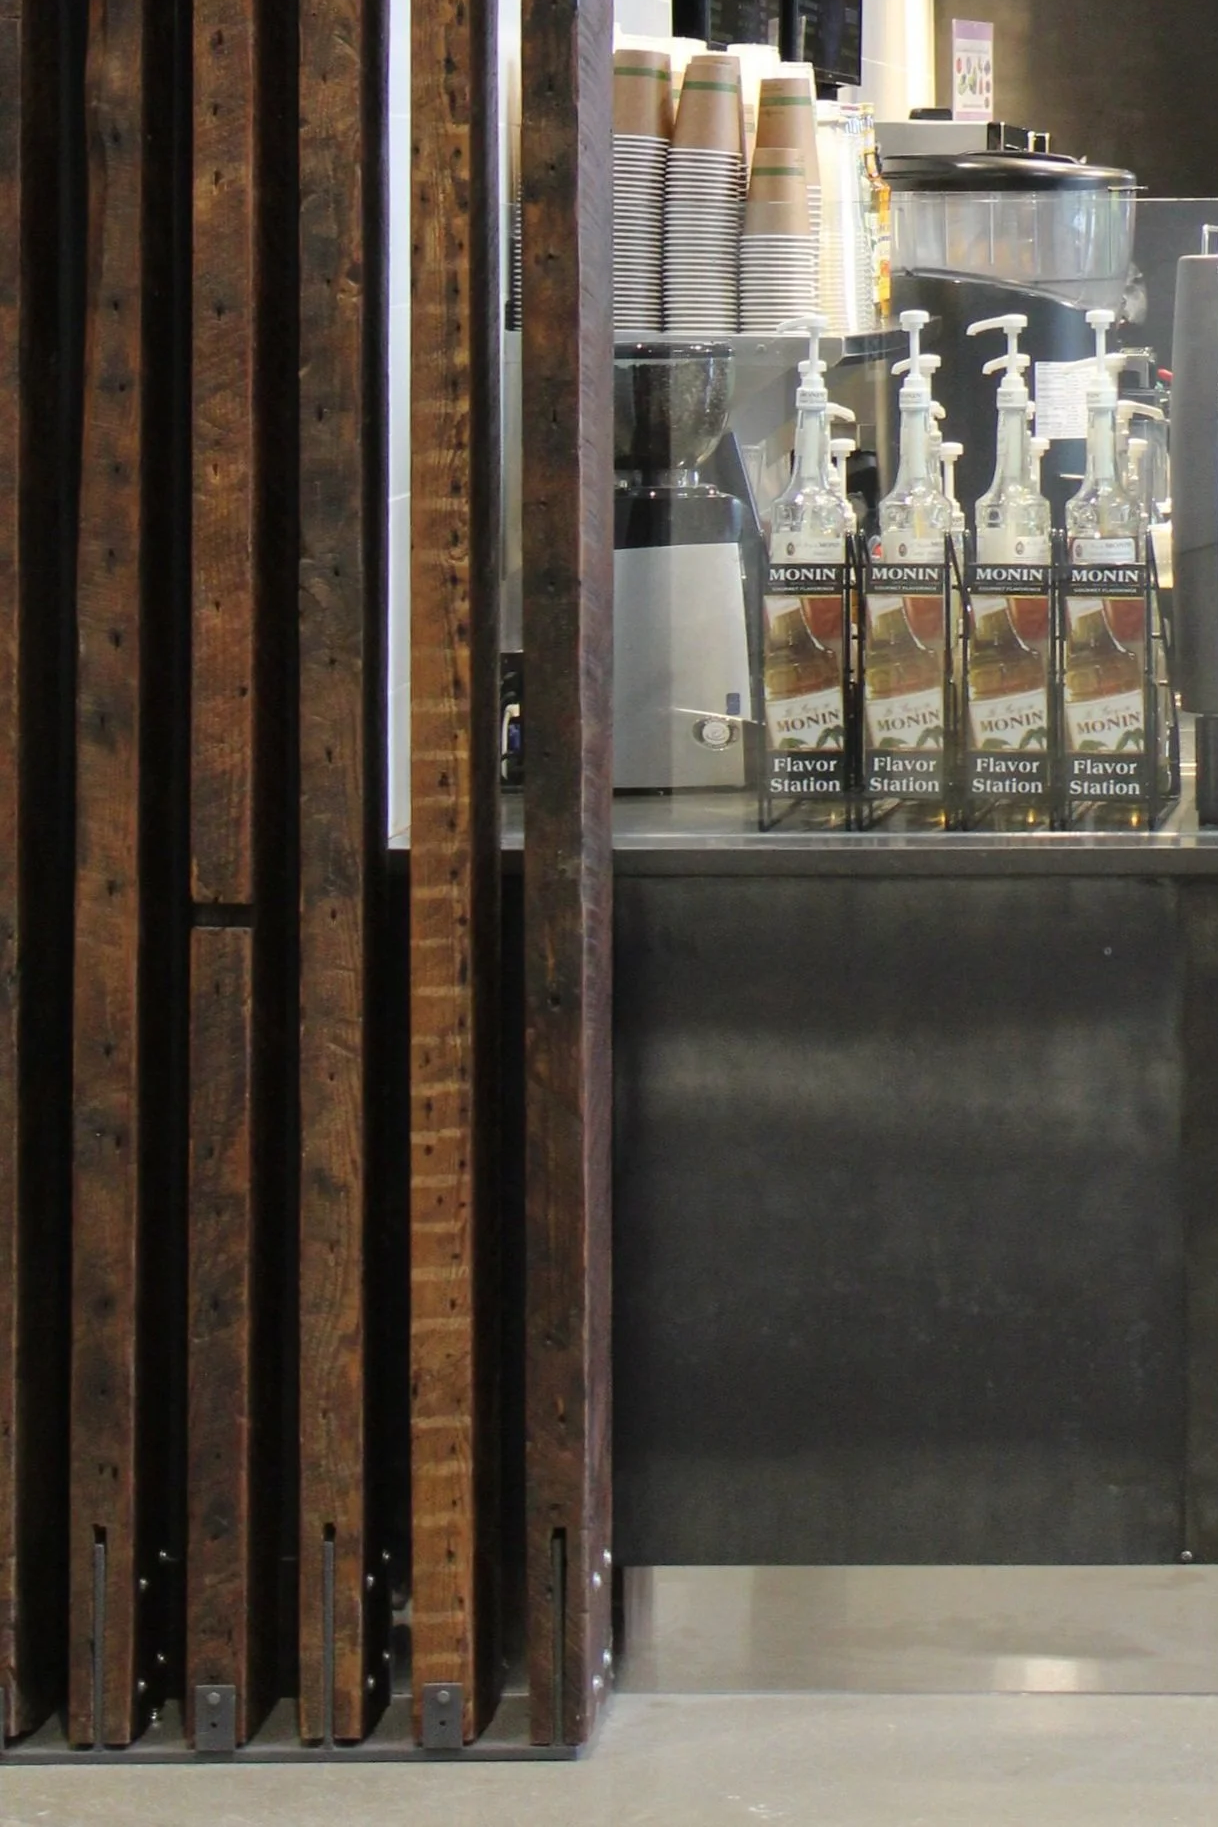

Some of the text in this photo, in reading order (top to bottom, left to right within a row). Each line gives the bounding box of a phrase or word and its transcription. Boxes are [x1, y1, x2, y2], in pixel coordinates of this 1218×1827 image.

[769, 568, 836, 581] MONIN
[872, 567, 939, 580] MONIN
[976, 568, 1043, 581] MONIN
[1071, 570, 1139, 582] MONIN
[776, 709, 841, 733] MONIN
[876, 709, 941, 732] MONIN
[979, 710, 1044, 733] MONIN
[1076, 711, 1142, 735] MONIN
[774, 757, 838, 773] Flavor
[873, 757, 937, 772] Flavor
[976, 758, 1041, 773] Flavor
[1073, 759, 1138, 775] Flavor
[770, 776, 841, 793] Station
[869, 776, 940, 792] Station
[971, 777, 1043, 793] Station
[1069, 779, 1141, 795] Station
